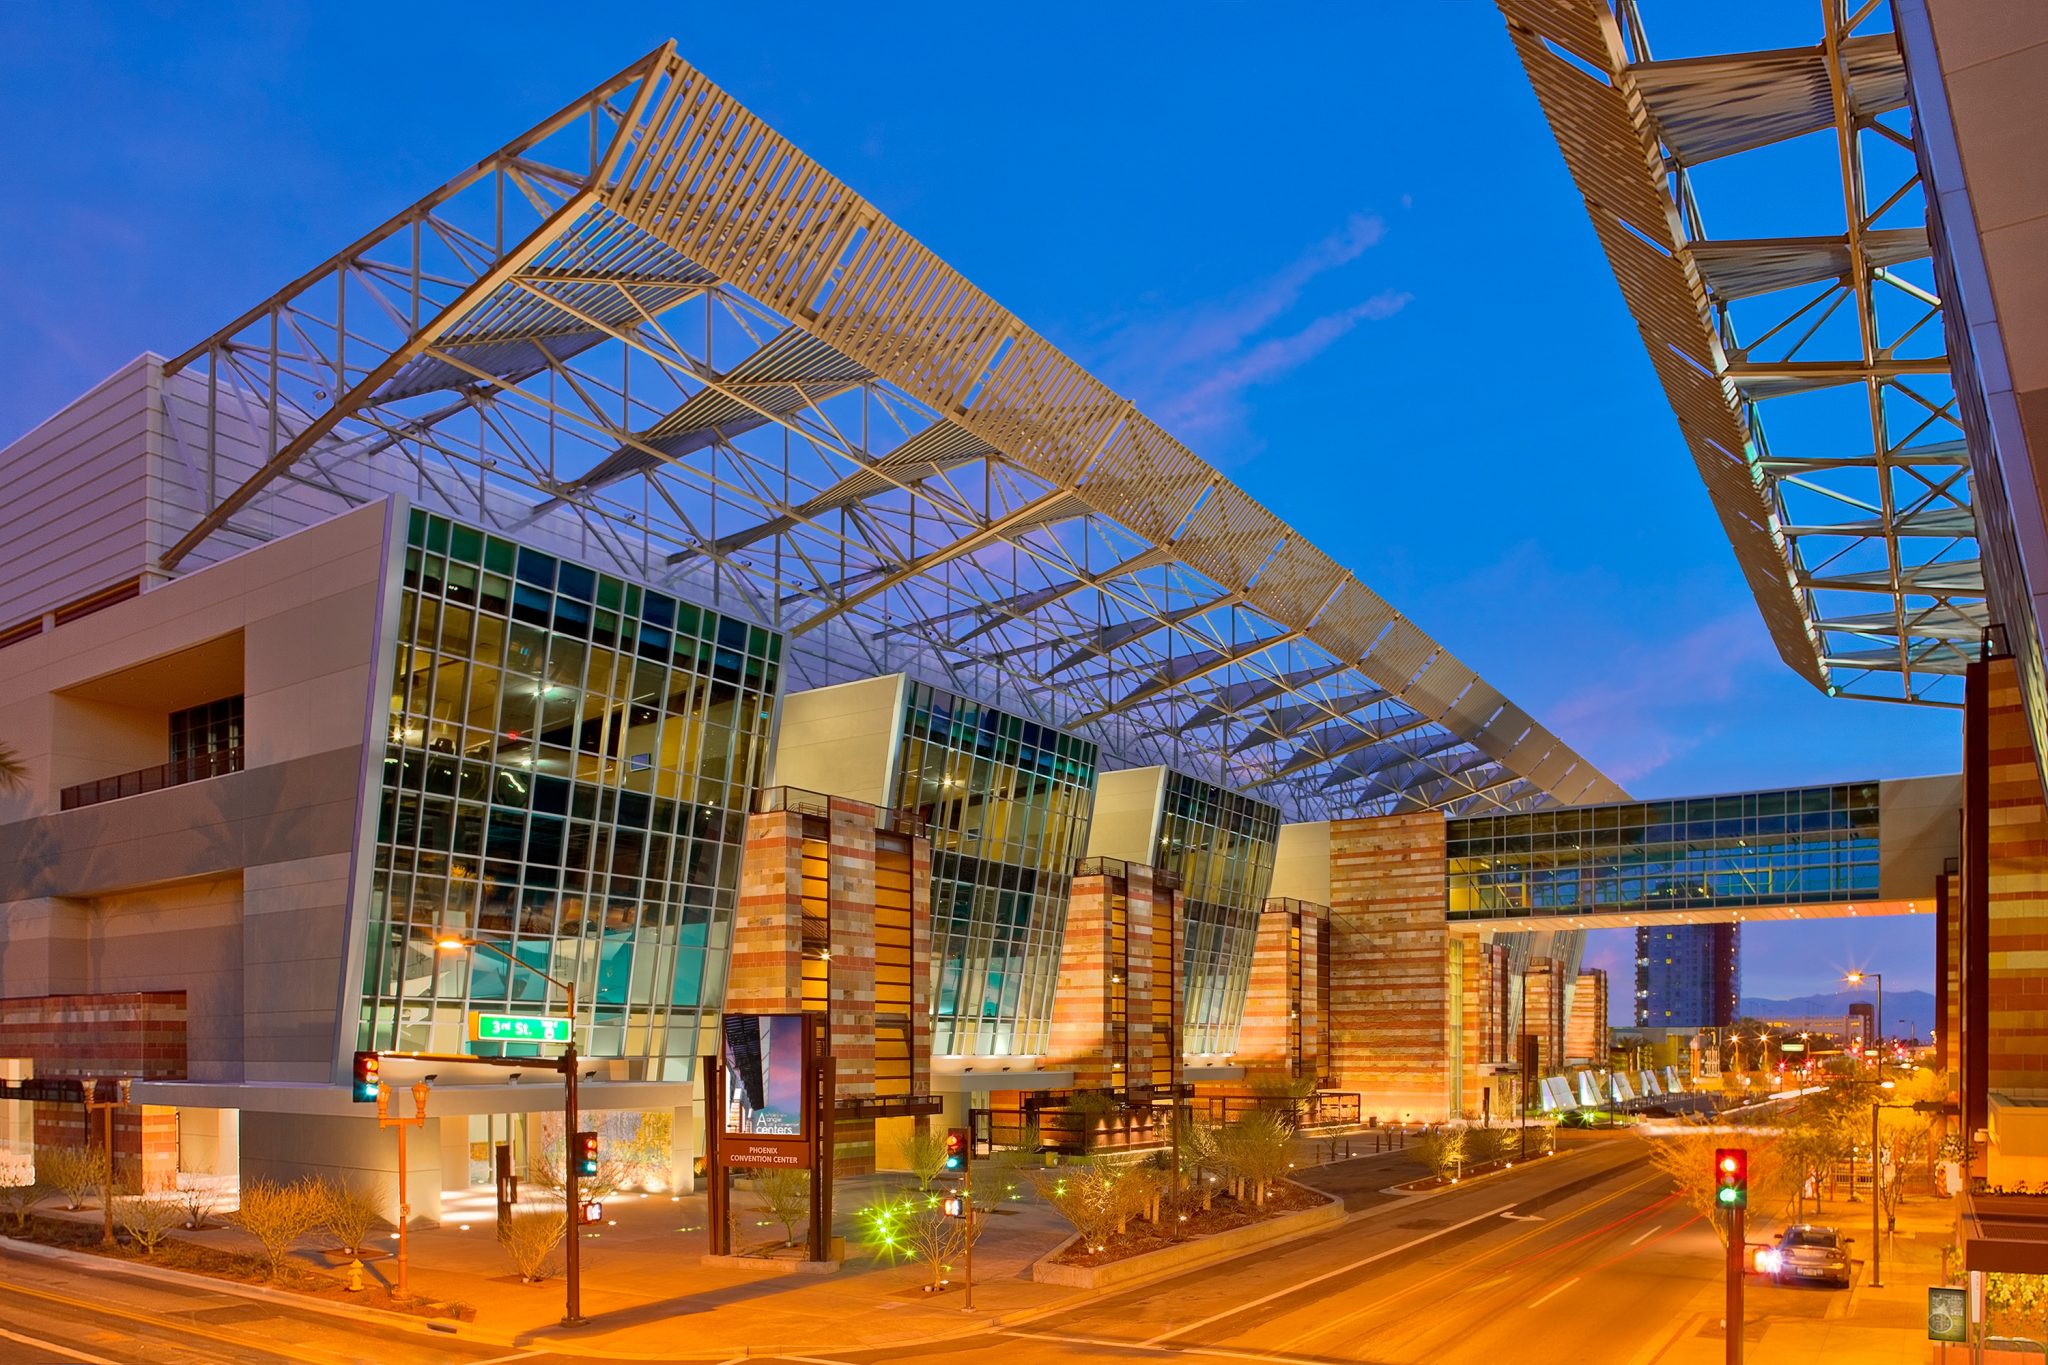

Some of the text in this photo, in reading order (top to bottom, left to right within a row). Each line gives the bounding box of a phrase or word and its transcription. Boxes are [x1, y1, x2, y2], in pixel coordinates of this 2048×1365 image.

[492, 1020, 511, 1034] 3rd
[515, 1021, 532, 1036] St.
[756, 1112, 767, 1126] A
[756, 1124, 793, 1134] centers
[749, 1146, 778, 1154] PHOENIX
[730, 1154, 798, 1164] CONVENTION CENTER
